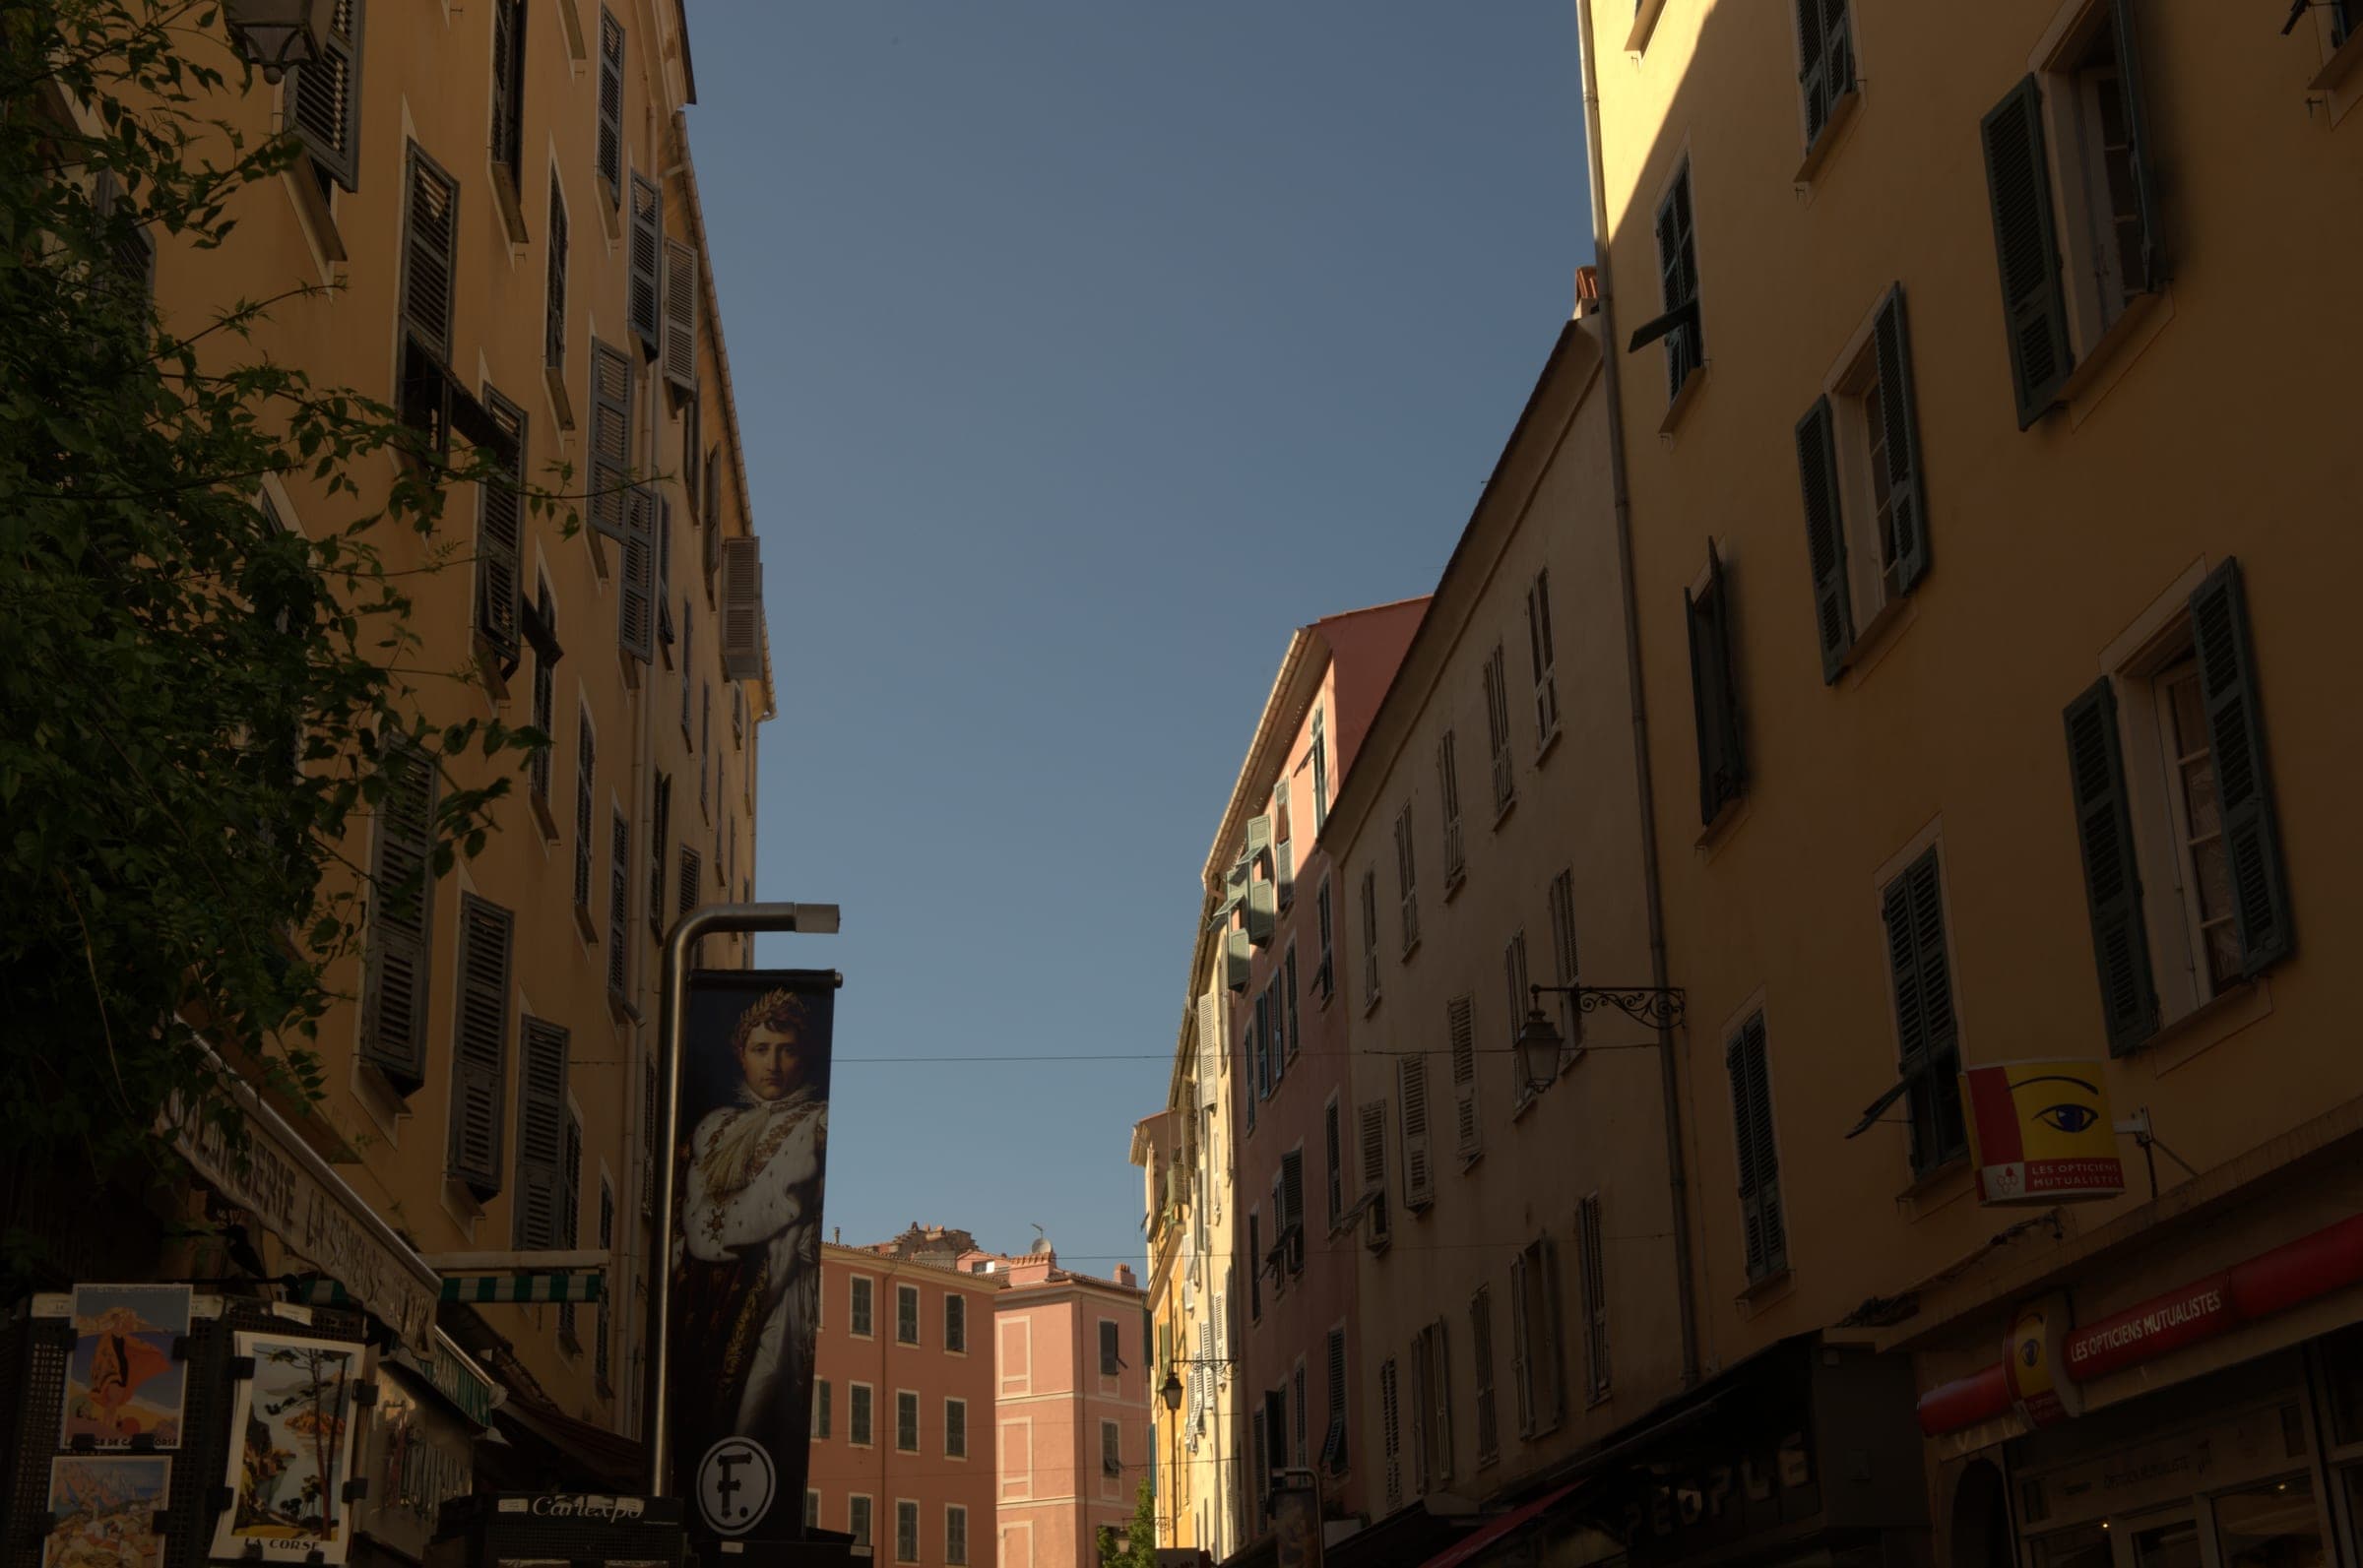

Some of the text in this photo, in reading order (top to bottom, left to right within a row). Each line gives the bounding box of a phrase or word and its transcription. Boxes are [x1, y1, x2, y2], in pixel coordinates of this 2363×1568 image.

[2031, 1164, 2057, 1175] LES
[2058, 1162, 2118, 1173] OPTICIENS
[2033, 1174, 2120, 1189] MUTUALISTES
[2070, 1289, 2222, 1362] LES OPTICIENS MUTUALISTES
[153, 1437, 177, 1447] ORSE
